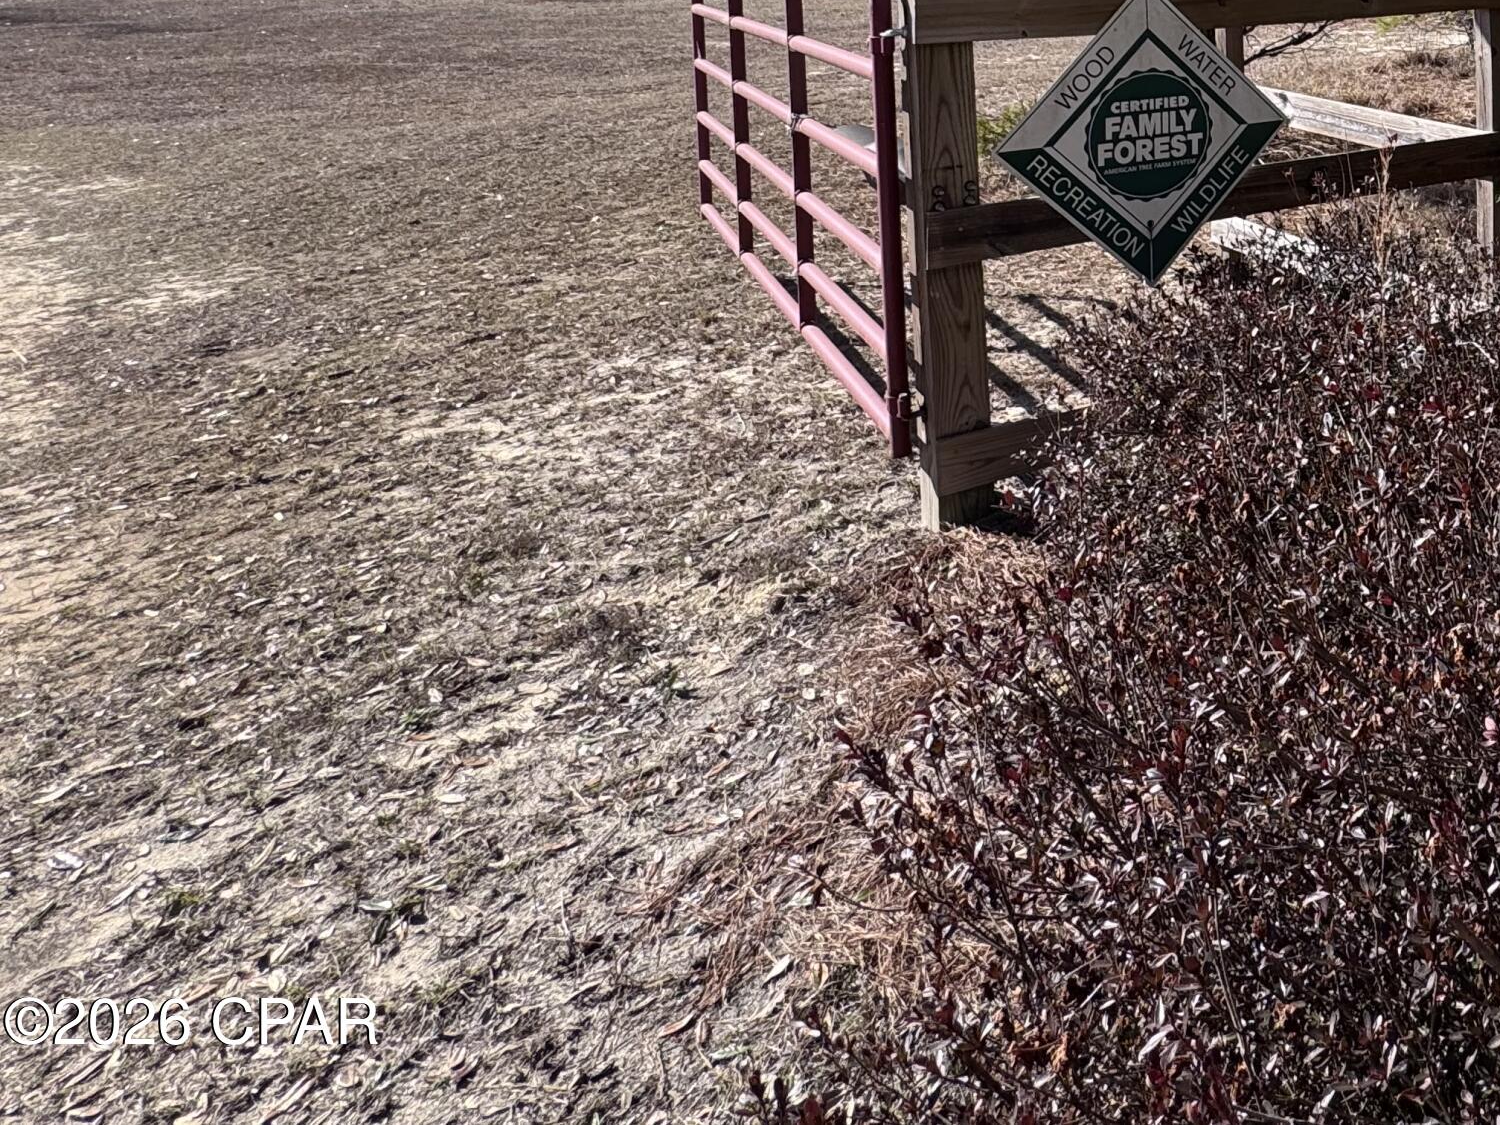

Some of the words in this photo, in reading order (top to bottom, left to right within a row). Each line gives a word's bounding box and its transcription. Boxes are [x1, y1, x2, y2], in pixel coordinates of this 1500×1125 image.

[1054, 46, 1115, 110] WOOD
[1178, 34, 1236, 96] WATER
[1105, 108, 1197, 141] FAMILY
[1110, 95, 1190, 115] CERTIFIED
[1097, 133, 1203, 167] FOREST
[1104, 165, 1137, 175] AMERICAN
[1139, 163, 1152, 171] TREE
[1154, 161, 1171, 169] FARM
[1172, 158, 1197, 168] SYSTEM
[1026, 155, 1145, 259] RECREATION
[1171, 145, 1249, 234] WILDLIFE
